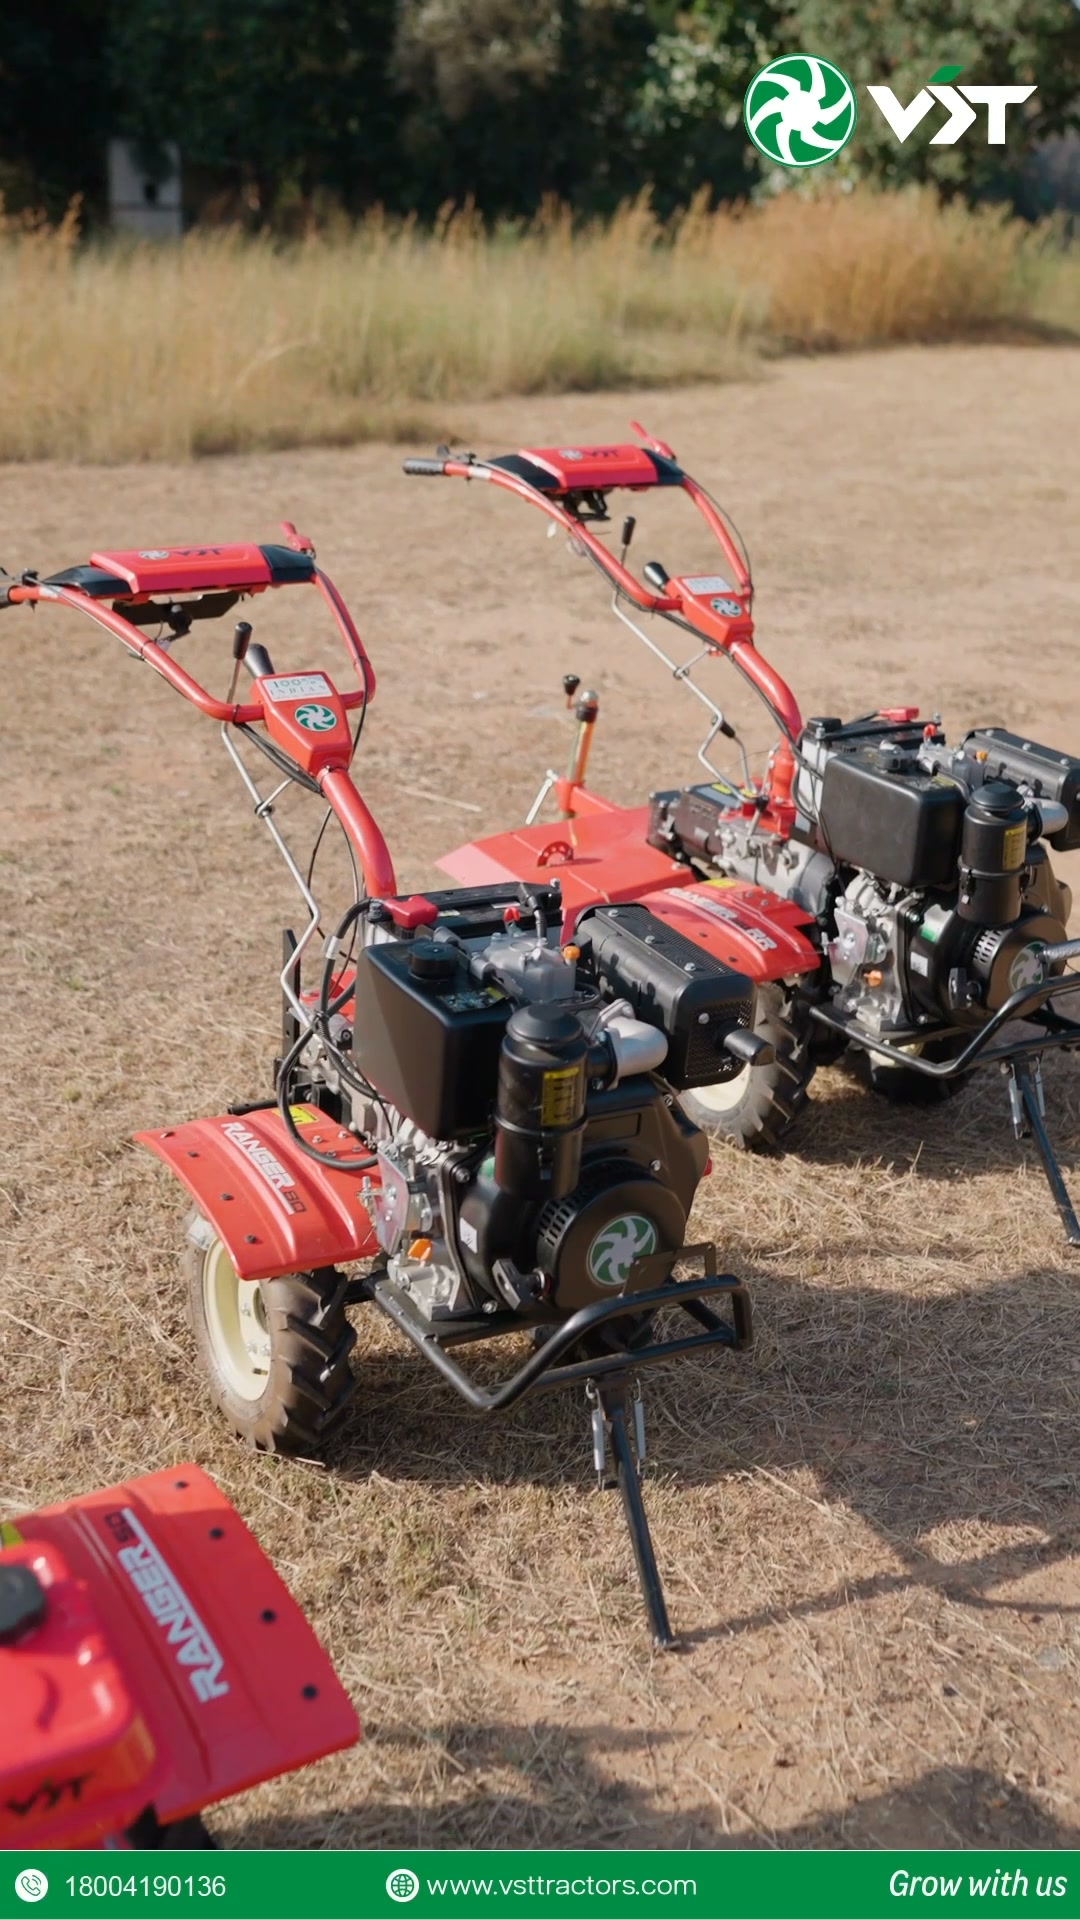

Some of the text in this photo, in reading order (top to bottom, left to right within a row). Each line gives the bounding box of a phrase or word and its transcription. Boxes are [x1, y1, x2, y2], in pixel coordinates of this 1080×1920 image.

[273, 678, 317, 688] 100%
[221, 1121, 296, 1197] RANGER
[117, 1535, 230, 1704] RANGER
[7, 1770, 97, 1817] VST
